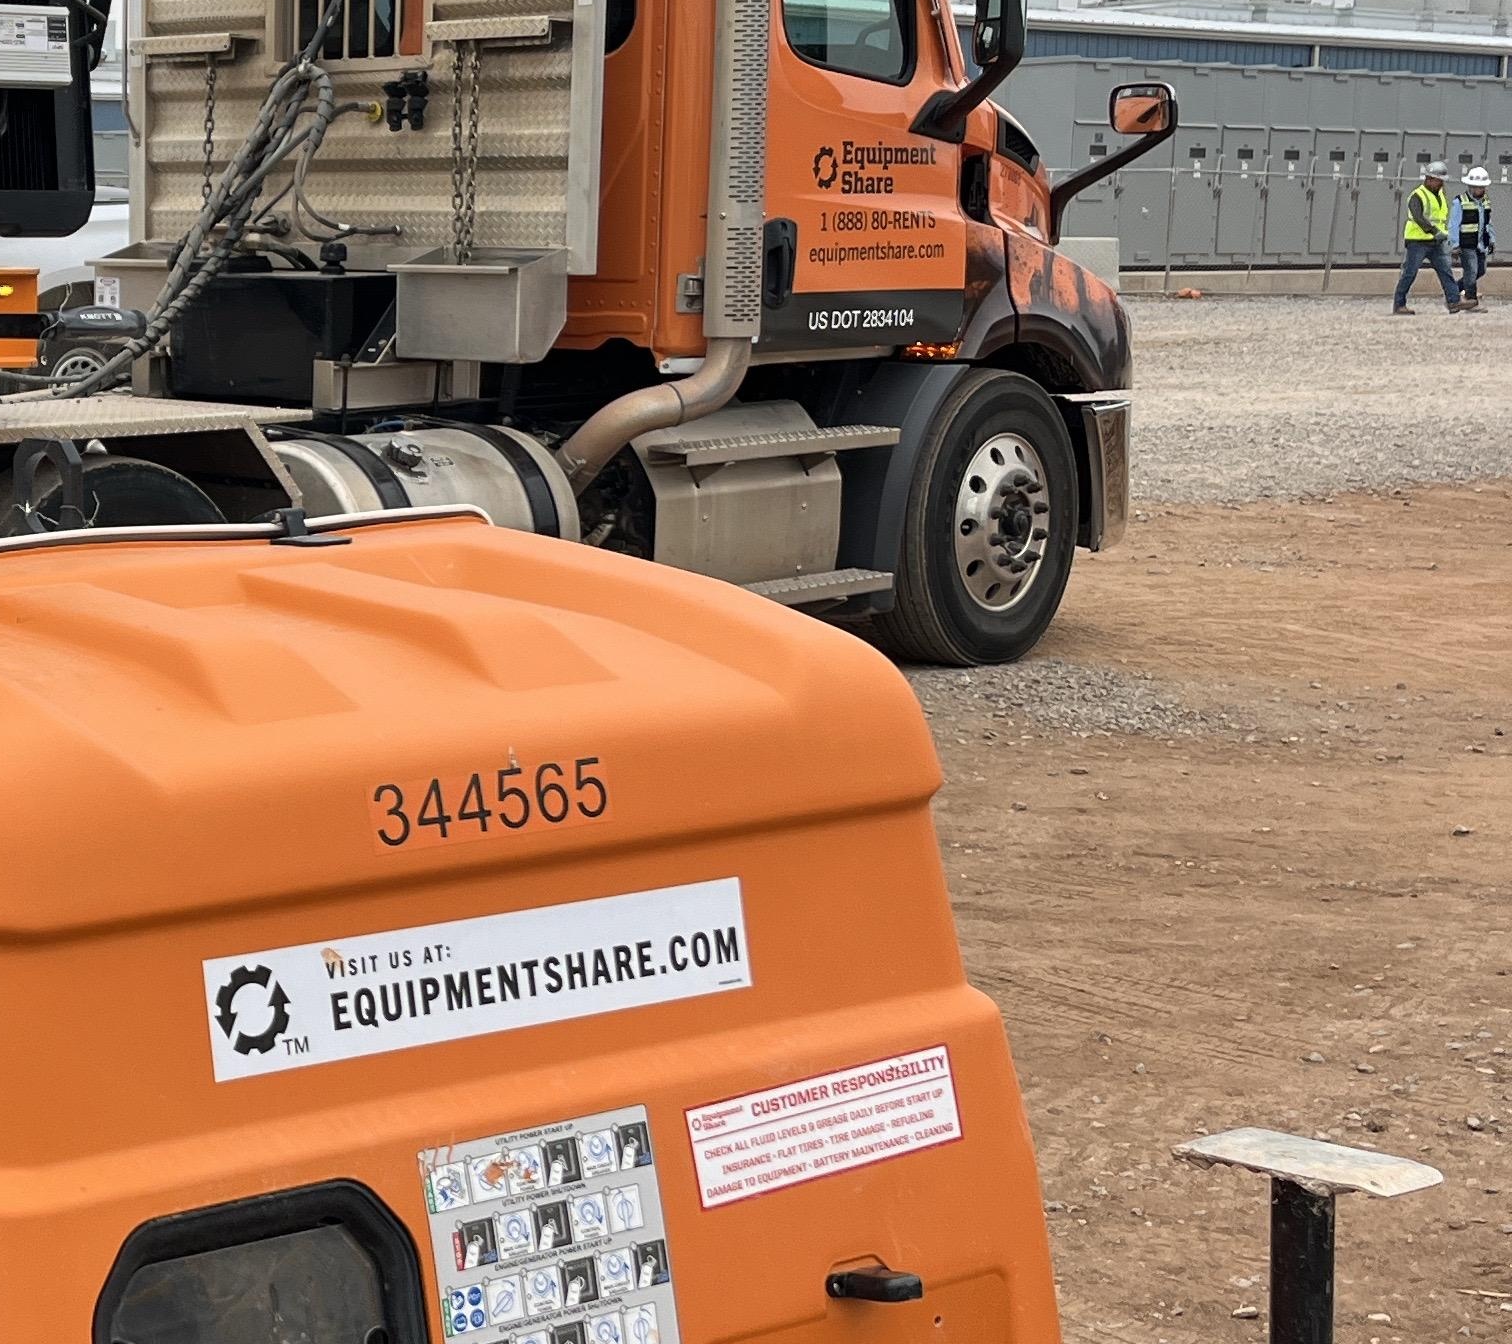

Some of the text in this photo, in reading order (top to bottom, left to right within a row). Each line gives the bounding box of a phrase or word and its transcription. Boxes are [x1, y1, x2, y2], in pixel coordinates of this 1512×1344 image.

[841, 141, 937, 171] Equipment
[841, 171, 894, 194] Share
[821, 210, 936, 234] 1 (888) 80-RENTS
[809, 241, 945, 265] equipmentshare.com
[808, 308, 914, 330] US DOT 2834104
[373, 757, 607, 847] 344565
[326, 943, 452, 979] VISIT US AT:
[330, 926, 740, 1031] EQUIPMENTSHARE.COM
[282, 1036, 311, 1056] TM
[751, 1055, 945, 1117] CUSTOMER RESPONSIBILITY
[520, 1128, 545, 1142] POWER
[546, 1125, 564, 1137] START
[564, 1123, 574, 1132] UP
[704, 1144, 733, 1160] CHECK
[735, 1140, 751, 1151] ALL
[751, 1132, 776, 1147] FLUID
[778, 1124, 808, 1140] LEVELS
[816, 1113, 849, 1131] GREASE
[850, 1106, 874, 1121] DAILY
[875, 1098, 905, 1114] BEFORE
[907, 1091, 933, 1106] START
[933, 1087, 944, 1099] UP
[722, 1110, 935, 1175] INSURANCE FLAT TIRES TIRE DAMAGE REFUELING
[706, 1123, 954, 1199] DAMAGE TO EQUIPMENT BATTERY MAINTENANCE CLEANING
[603, 1237, 612, 1247] UP
